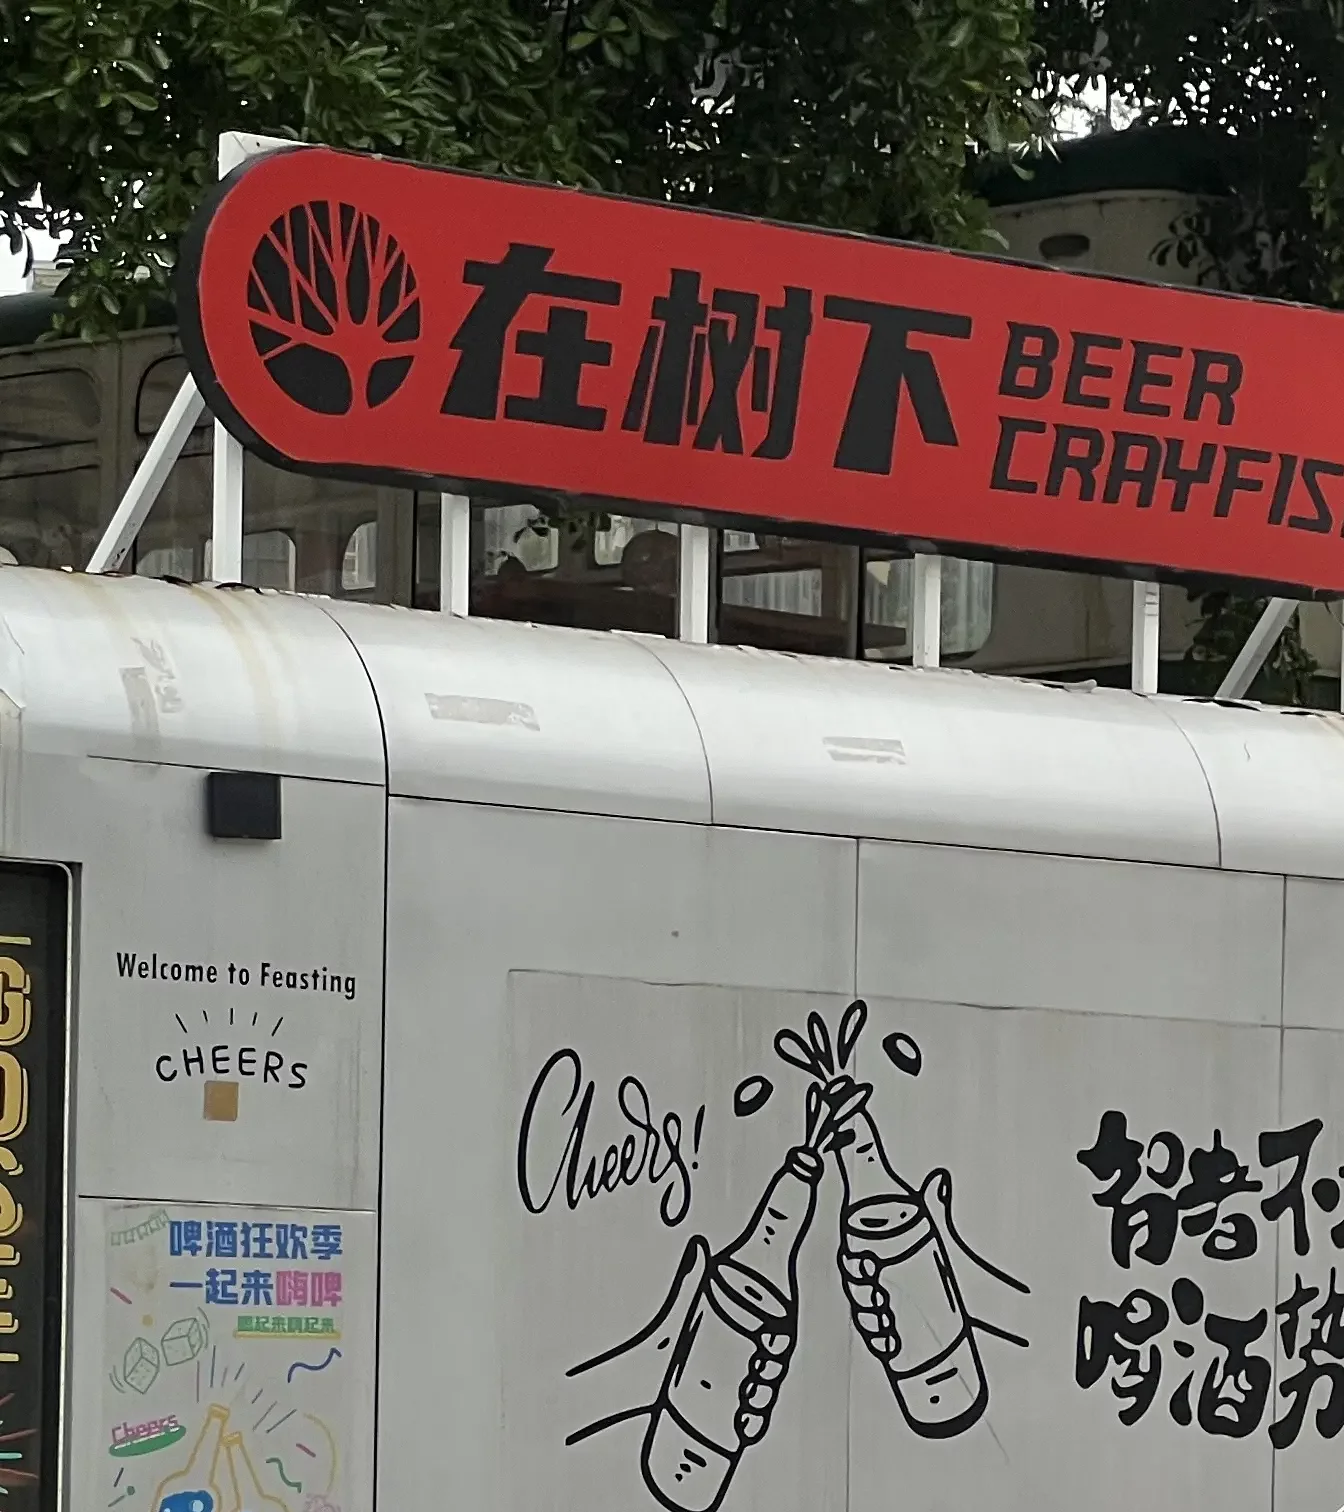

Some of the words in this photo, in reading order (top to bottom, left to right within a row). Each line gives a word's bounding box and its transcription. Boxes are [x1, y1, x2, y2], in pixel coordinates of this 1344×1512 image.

[439, 242, 972, 476] 在树下
[998, 321, 1244, 426] BEER
[117, 952, 218, 985] Welcome
[228, 962, 250, 986] to
[261, 961, 357, 1000] Feasting
[155, 1045, 309, 1090] CHEERS
[169, 1220, 343, 1260] 啤酒狂欢季
[111, 1414, 179, 1445] Cheers
